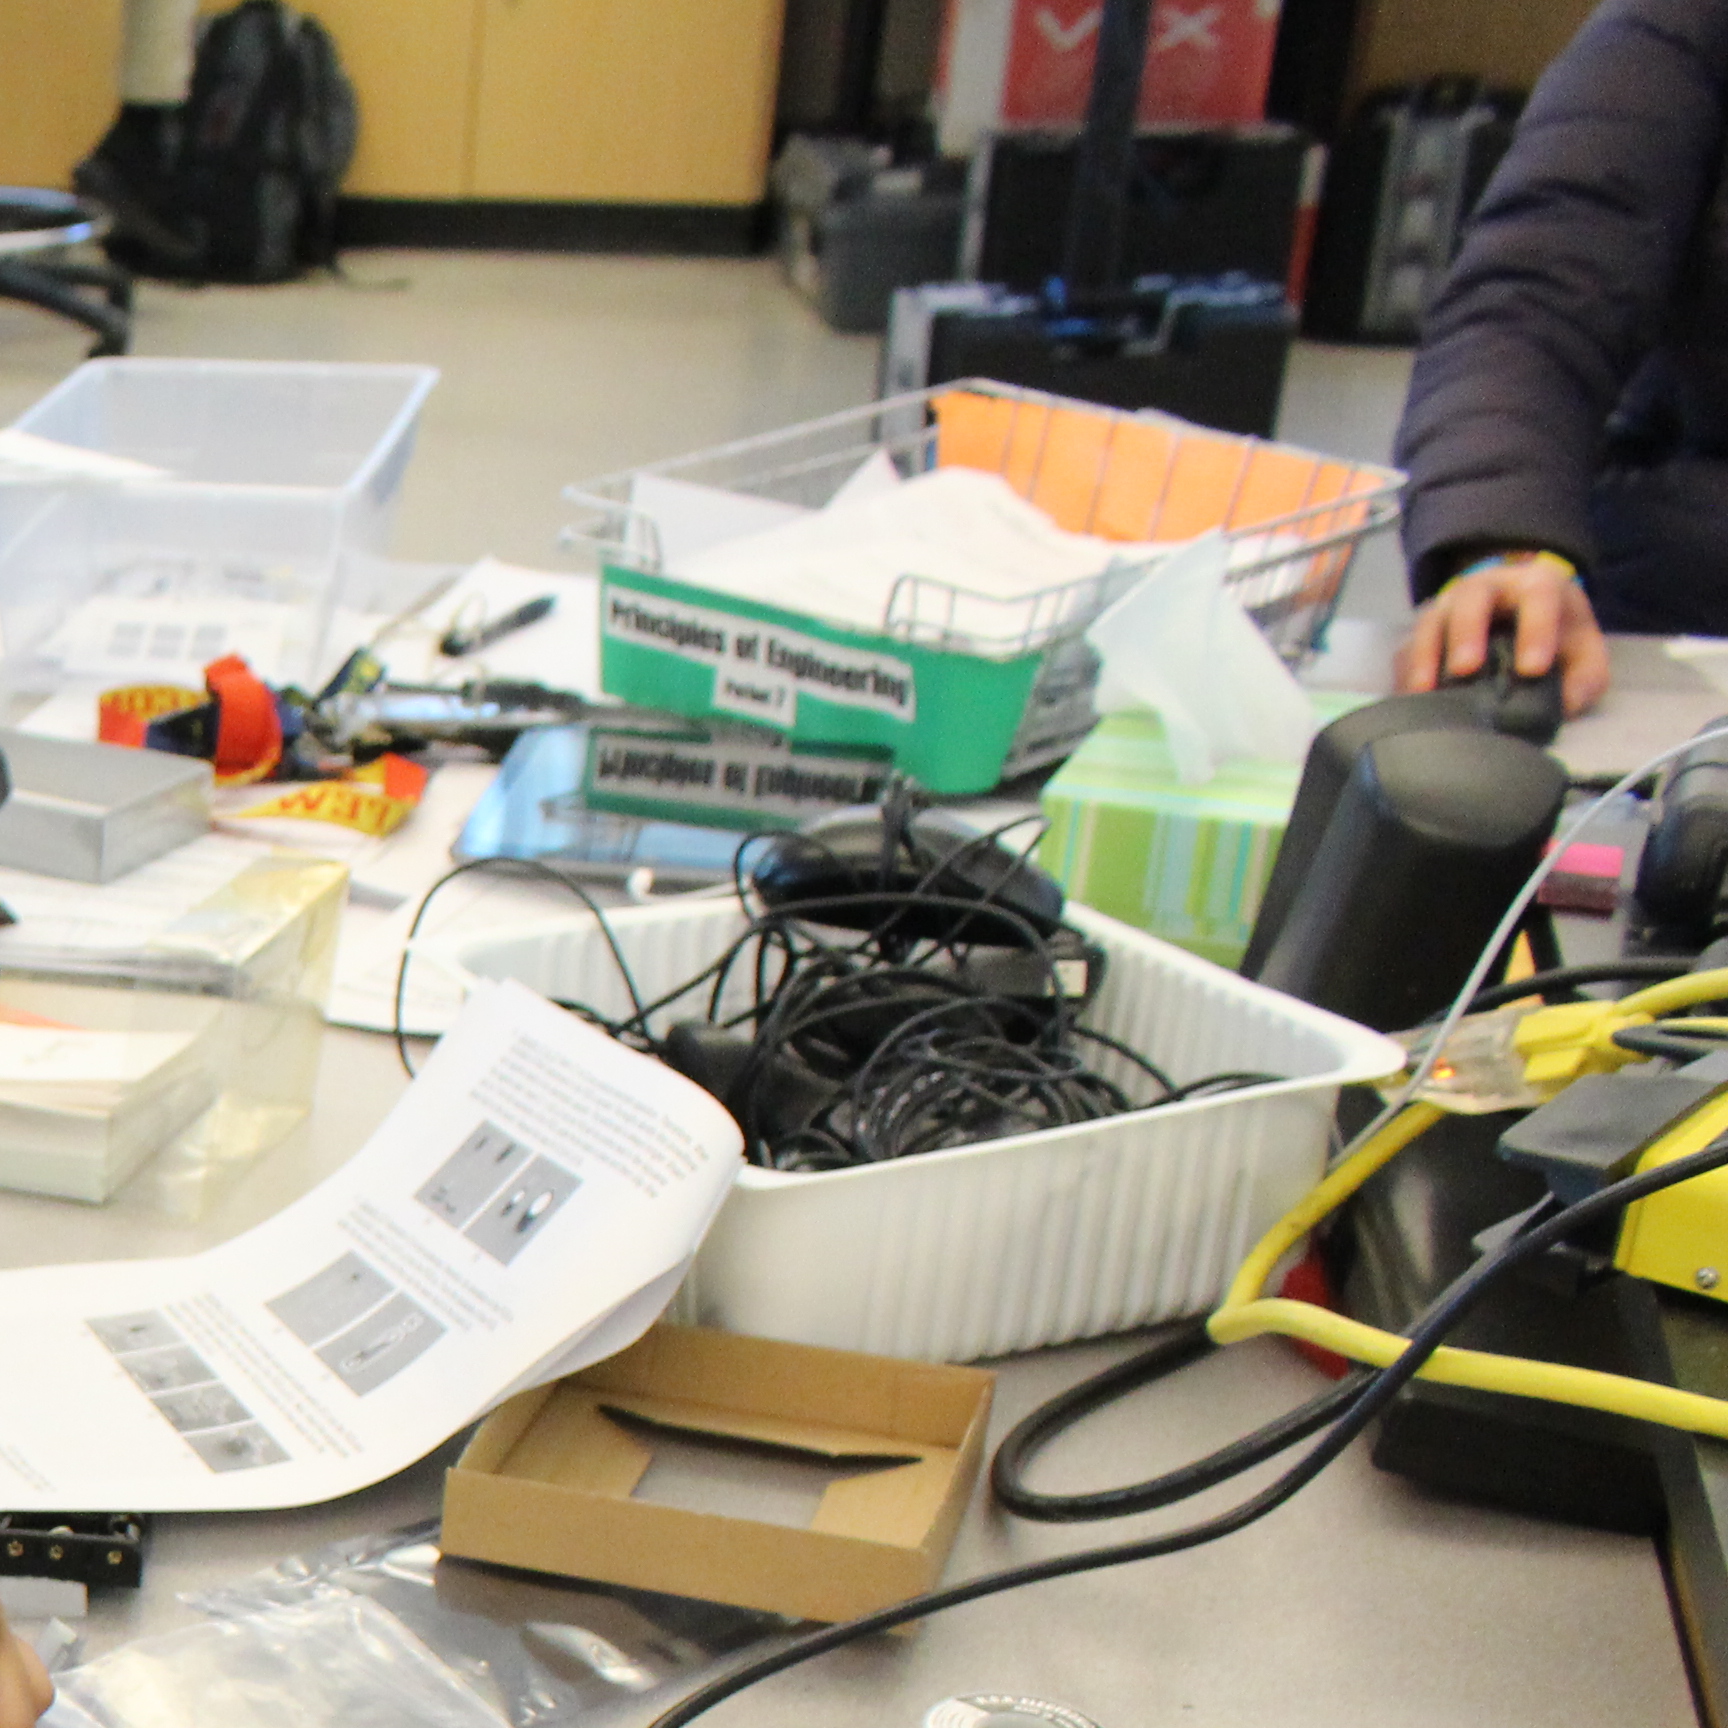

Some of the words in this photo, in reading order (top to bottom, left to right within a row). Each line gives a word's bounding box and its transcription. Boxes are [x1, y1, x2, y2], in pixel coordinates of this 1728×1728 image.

[611, 598, 723, 653] Principles
[735, 632, 760, 660] of
[766, 637, 908, 707] Engineering
